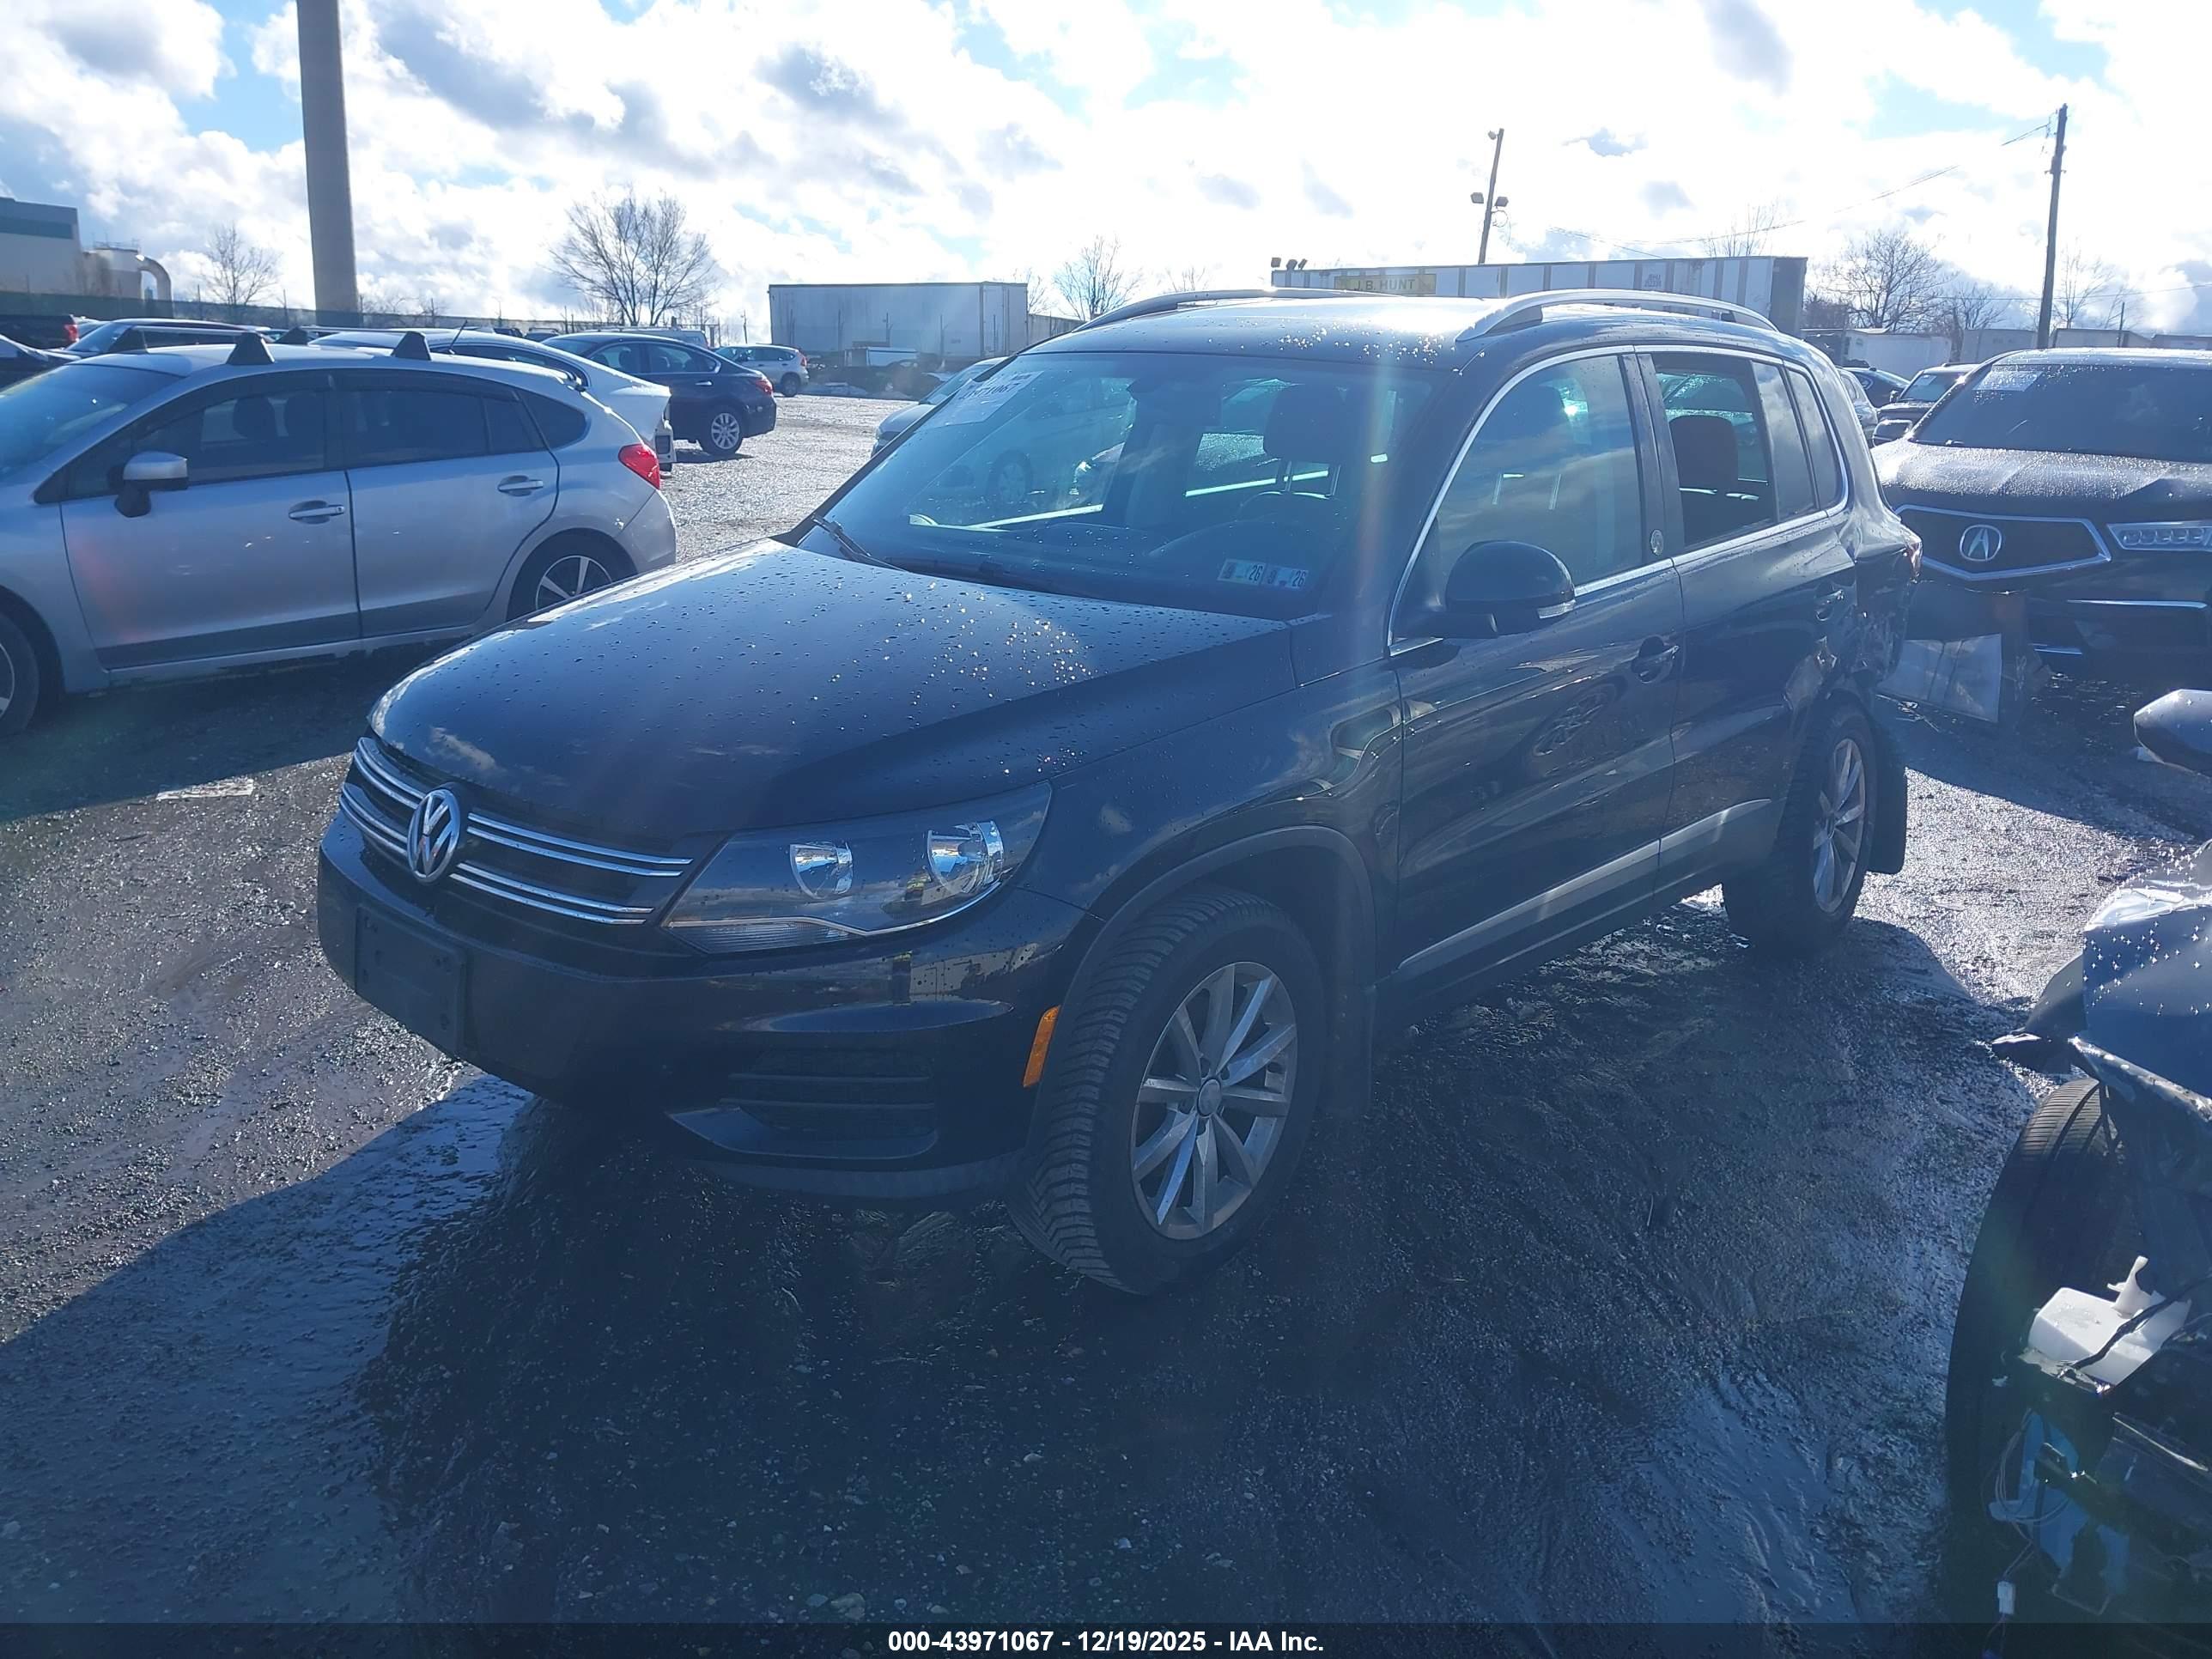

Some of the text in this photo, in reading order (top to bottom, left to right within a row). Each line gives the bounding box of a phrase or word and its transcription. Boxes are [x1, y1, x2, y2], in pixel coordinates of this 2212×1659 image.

[1379, 278, 1416, 290] HUNT
[1249, 564, 1264, 582] 26
[1291, 569, 1308, 588] 26
